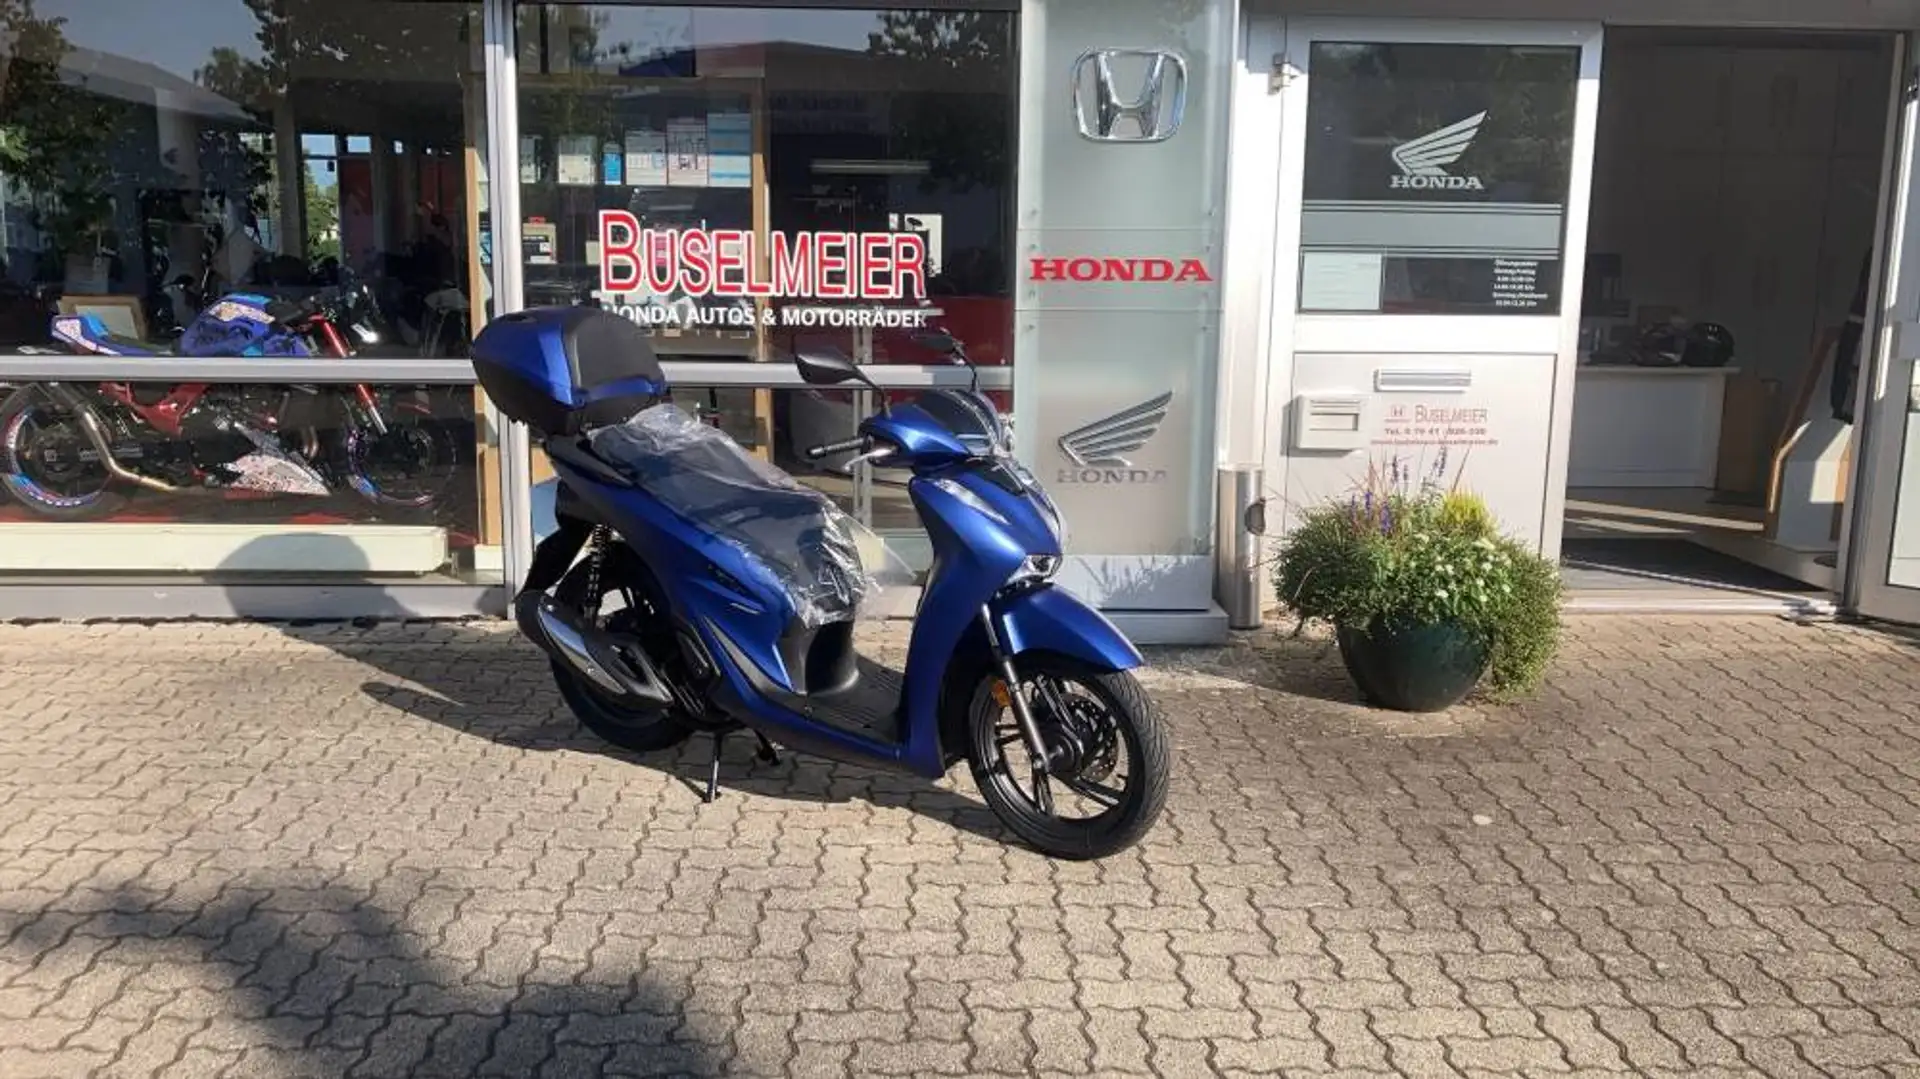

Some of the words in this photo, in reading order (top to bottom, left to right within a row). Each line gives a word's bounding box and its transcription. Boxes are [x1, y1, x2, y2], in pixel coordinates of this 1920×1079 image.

[1389, 174, 1484, 190] HONDA
[599, 209, 926, 299] BUSELMEIER
[1029, 257, 1213, 282] HONDA
[686, 305, 756, 325] AUTOS
[762, 307, 776, 326] &
[781, 304, 927, 328] MOTORRÄDER
[1057, 467, 1168, 484] HONDA
